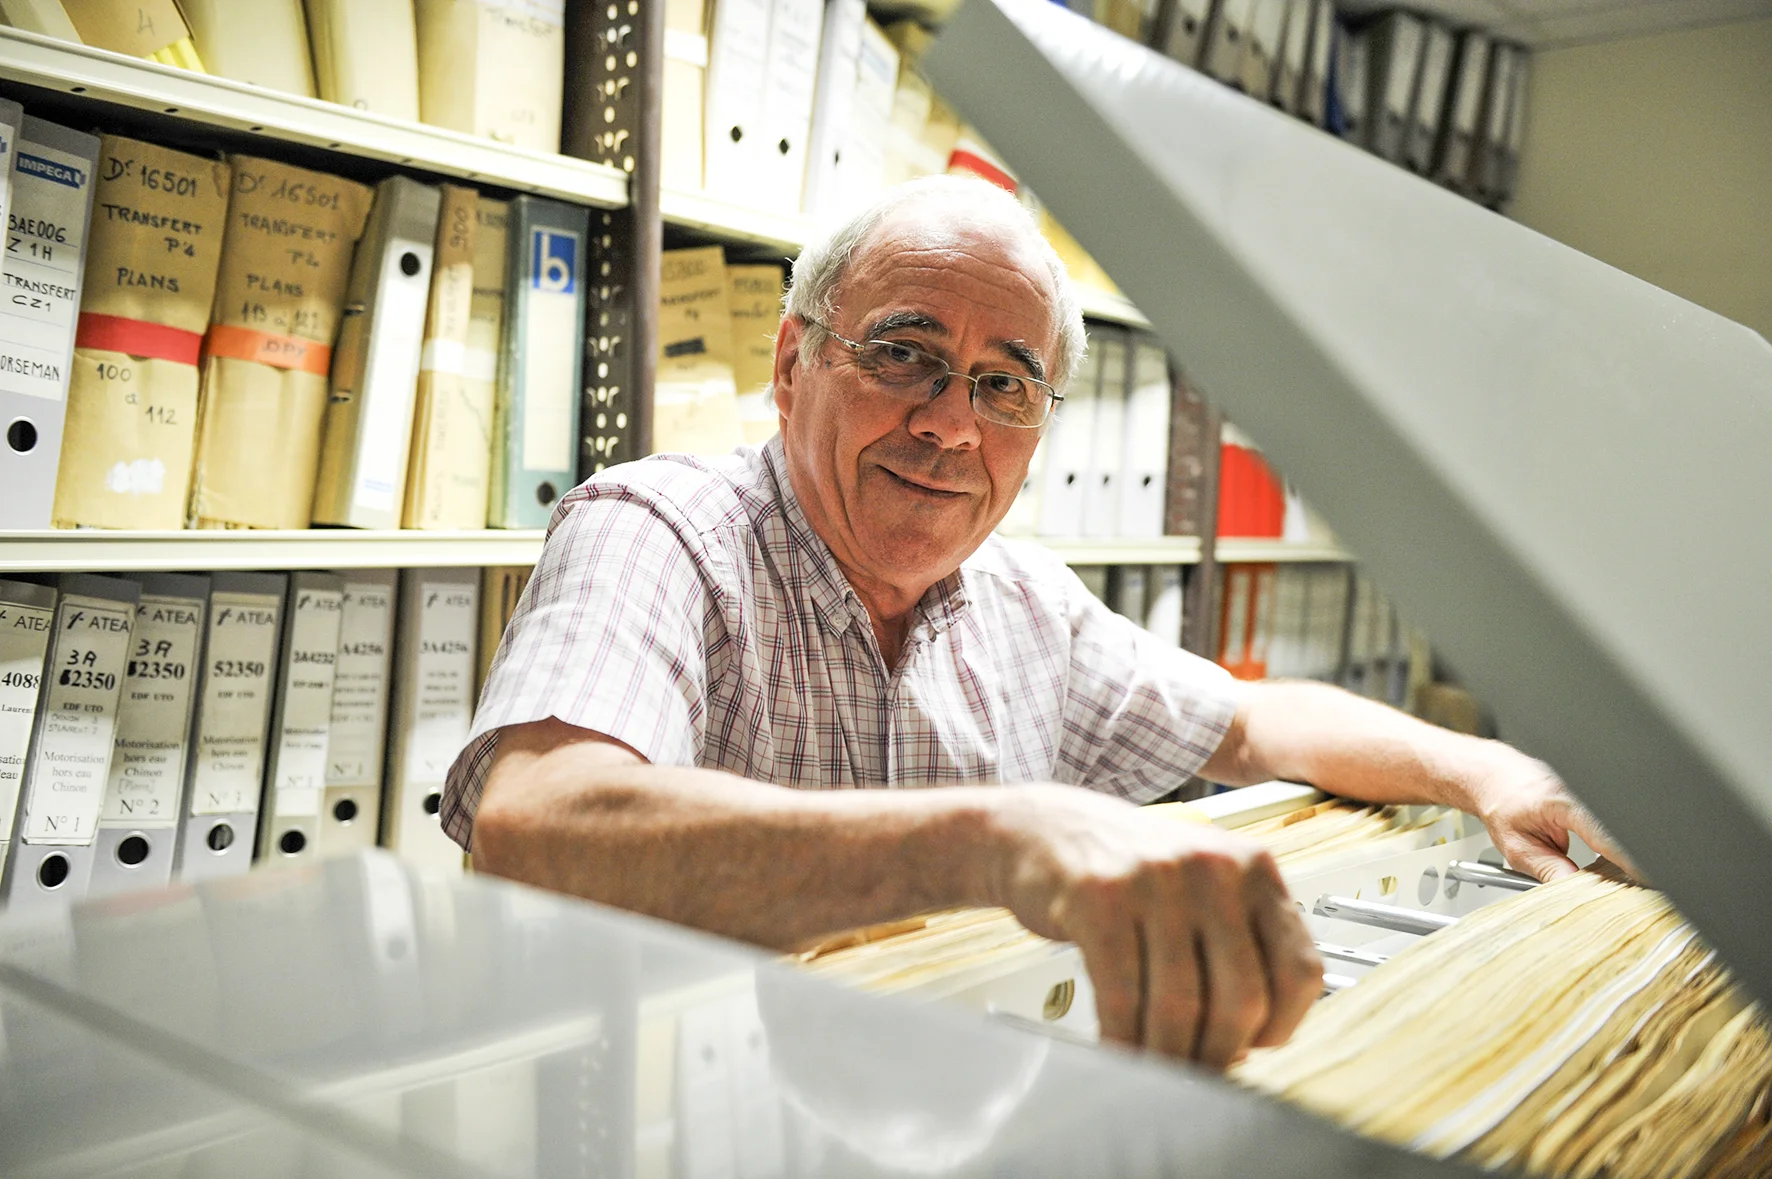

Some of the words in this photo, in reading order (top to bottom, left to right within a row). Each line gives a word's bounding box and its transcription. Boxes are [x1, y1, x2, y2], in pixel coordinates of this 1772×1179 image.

[19, 157, 72, 181] IMPEGA
[141, 165, 198, 198] 16501
[271, 179, 340, 211] 16501
[101, 203, 202, 235] TRANSFERT
[240, 212, 337, 244] TRANSFERT
[2, 272, 77, 301] TRANSFERT
[116, 267, 180, 293] PLANS
[246, 273, 304, 297] PLANS
[96, 363, 132, 382] 100
[145, 405, 178, 425] 112
[88, 616, 129, 633] ATEA
[153, 609, 196, 624] ATEA
[236, 610, 274, 625] ATEA
[213, 660, 265, 678] 52350
[131, 692, 149, 700] EDF
[63, 702, 81, 712] EDF
[84, 704, 103, 713] UTO
[115, 738, 180, 750] Motorisation
[44, 751, 105, 764] Motorisation
[124, 753, 146, 763] hors
[149, 755, 167, 764] eau
[52, 767, 73, 777] hors
[76, 769, 92, 778] eau
[125, 767, 163, 777] Chinon
[52, 781, 88, 793] Chinon
[149, 799, 159, 815] 2
